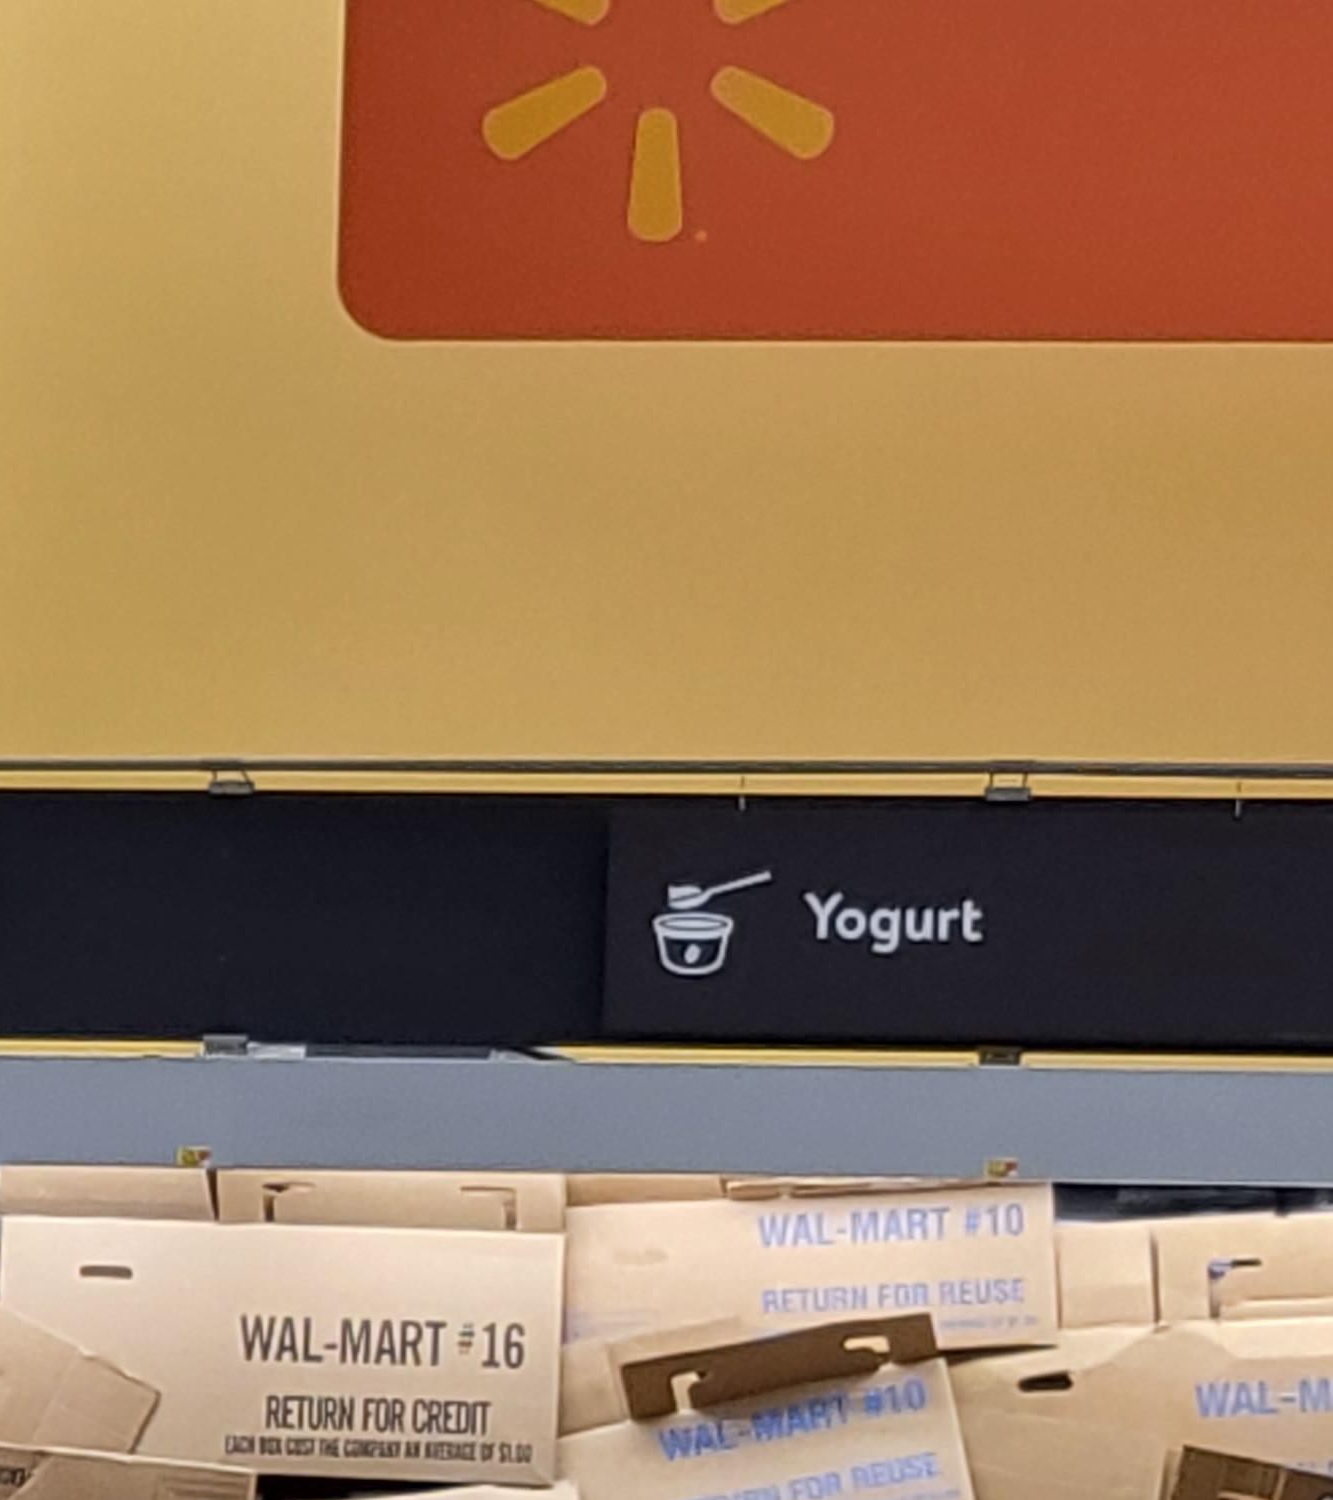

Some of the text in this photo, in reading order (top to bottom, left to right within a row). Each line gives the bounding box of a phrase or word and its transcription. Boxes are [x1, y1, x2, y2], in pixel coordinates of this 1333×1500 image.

[803, 891, 984, 954] Yogurt
[758, 1203, 1025, 1248] WAL-MART #10
[761, 1278, 1025, 1314] RETURN FOR REUSE
[240, 1313, 526, 1370] WAL-MART #16
[265, 1394, 492, 1437] RETURN FOR CREDIT
[659, 1378, 927, 1462] WAL-MART #10
[1195, 1379, 1333, 1419] WAL-M
[851, 1451, 940, 1490] REUSE
